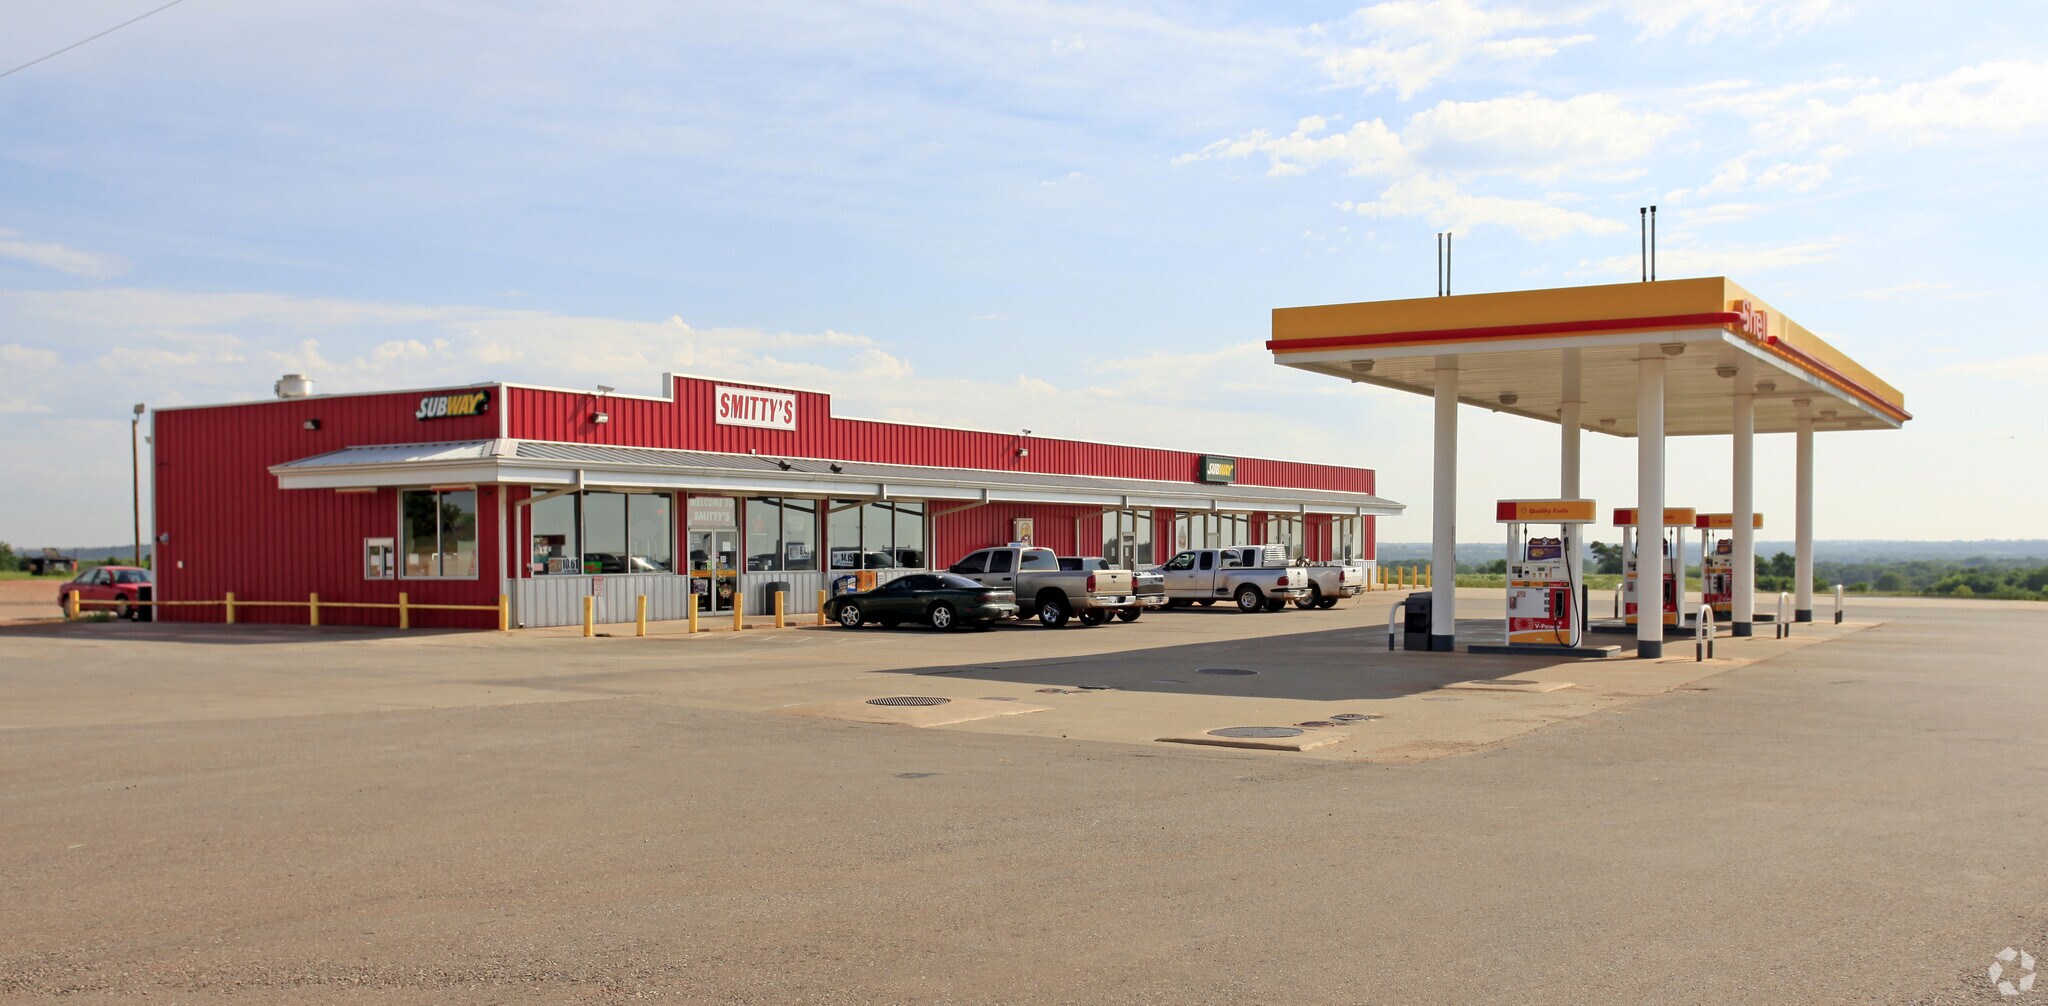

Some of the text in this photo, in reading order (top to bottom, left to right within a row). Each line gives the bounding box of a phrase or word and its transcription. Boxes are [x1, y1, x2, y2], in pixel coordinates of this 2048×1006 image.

[415, 392, 485, 419] SUBWAY
[720, 392, 793, 424] SMITTY'S
[1207, 462, 1234, 476] SUBWAY
[689, 497, 734, 508] WELCOME TO
[693, 511, 730, 521] SMITTY'S
[1529, 507, 1551, 515] Quality
[563, 558, 579, 570] 10.61
